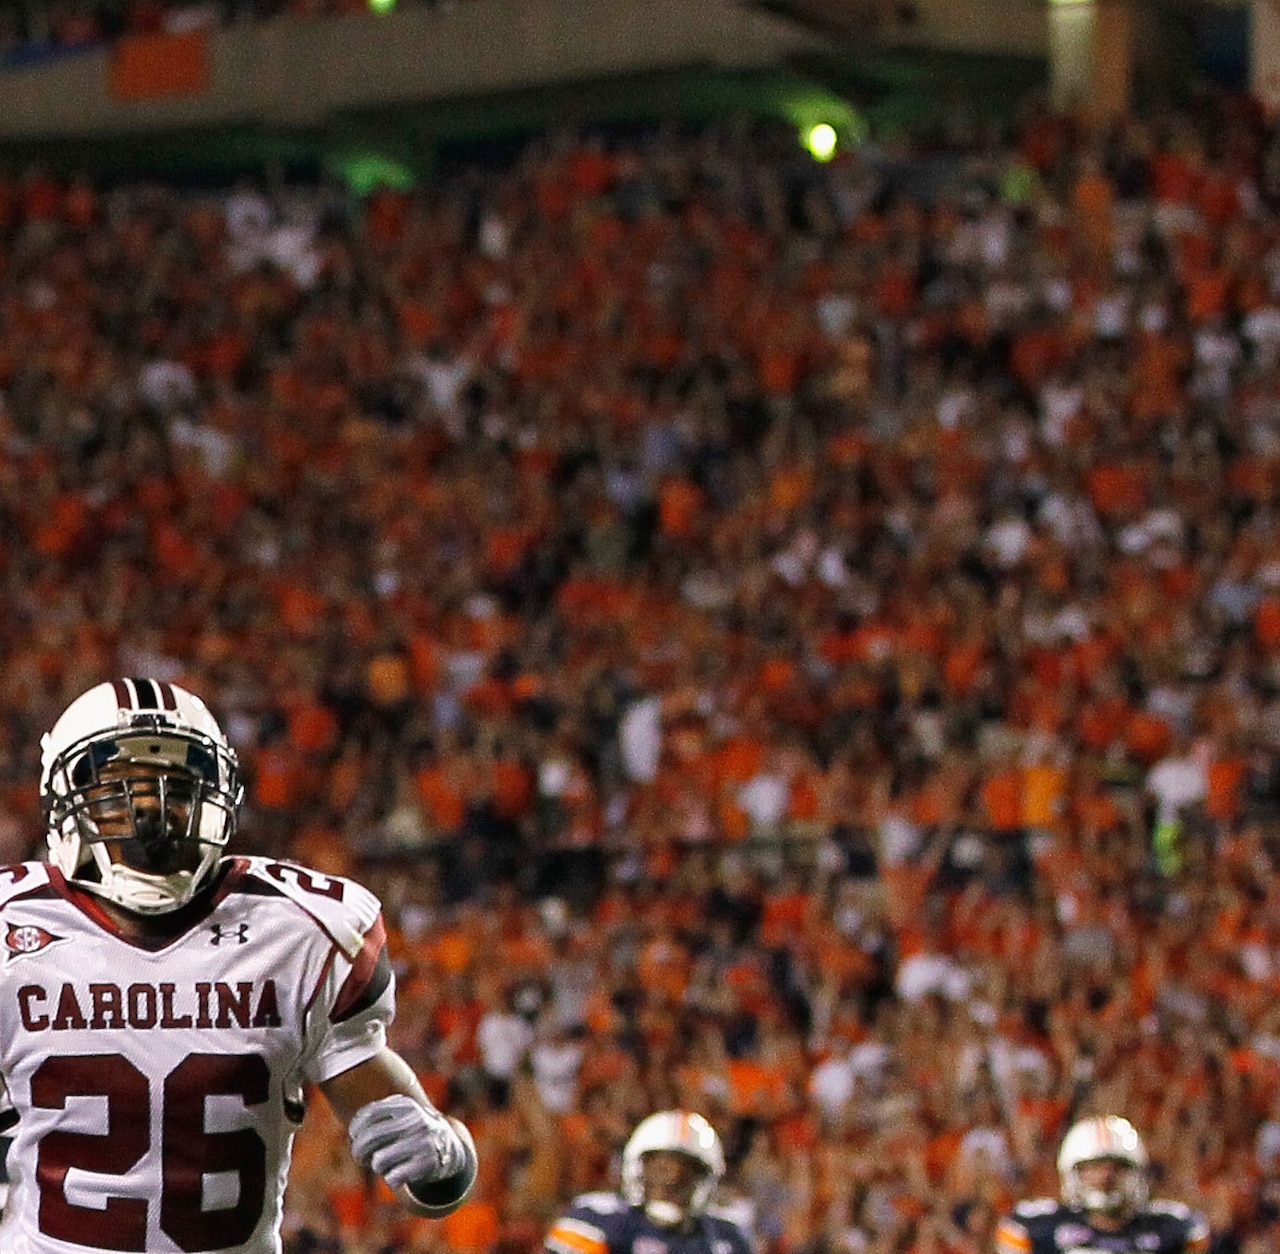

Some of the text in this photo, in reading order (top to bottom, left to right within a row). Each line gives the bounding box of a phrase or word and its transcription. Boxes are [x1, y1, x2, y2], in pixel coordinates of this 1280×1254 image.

[265, 862, 345, 902] 2
[17, 978, 282, 1032] CAROLINA
[29, 1051, 271, 1254] 26
